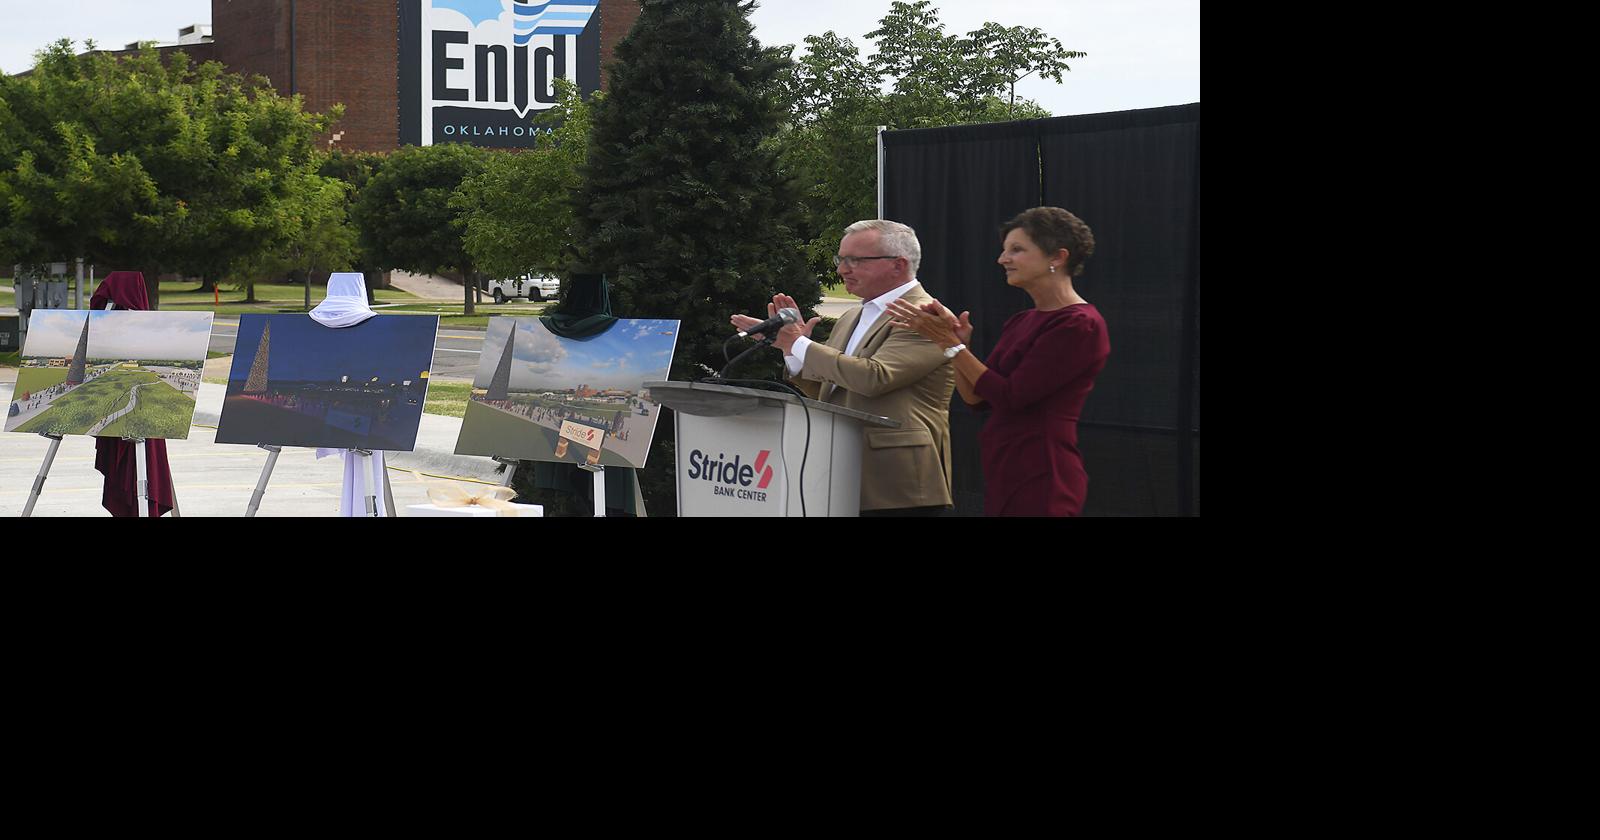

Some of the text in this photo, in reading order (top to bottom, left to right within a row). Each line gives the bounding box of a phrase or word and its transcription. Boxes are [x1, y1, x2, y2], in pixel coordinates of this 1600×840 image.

[432, 30, 566, 112] Enid
[443, 125, 553, 137] OKLAHOMA
[688, 449, 754, 487] Stride
[713, 485, 767, 502] BANK CENTER
